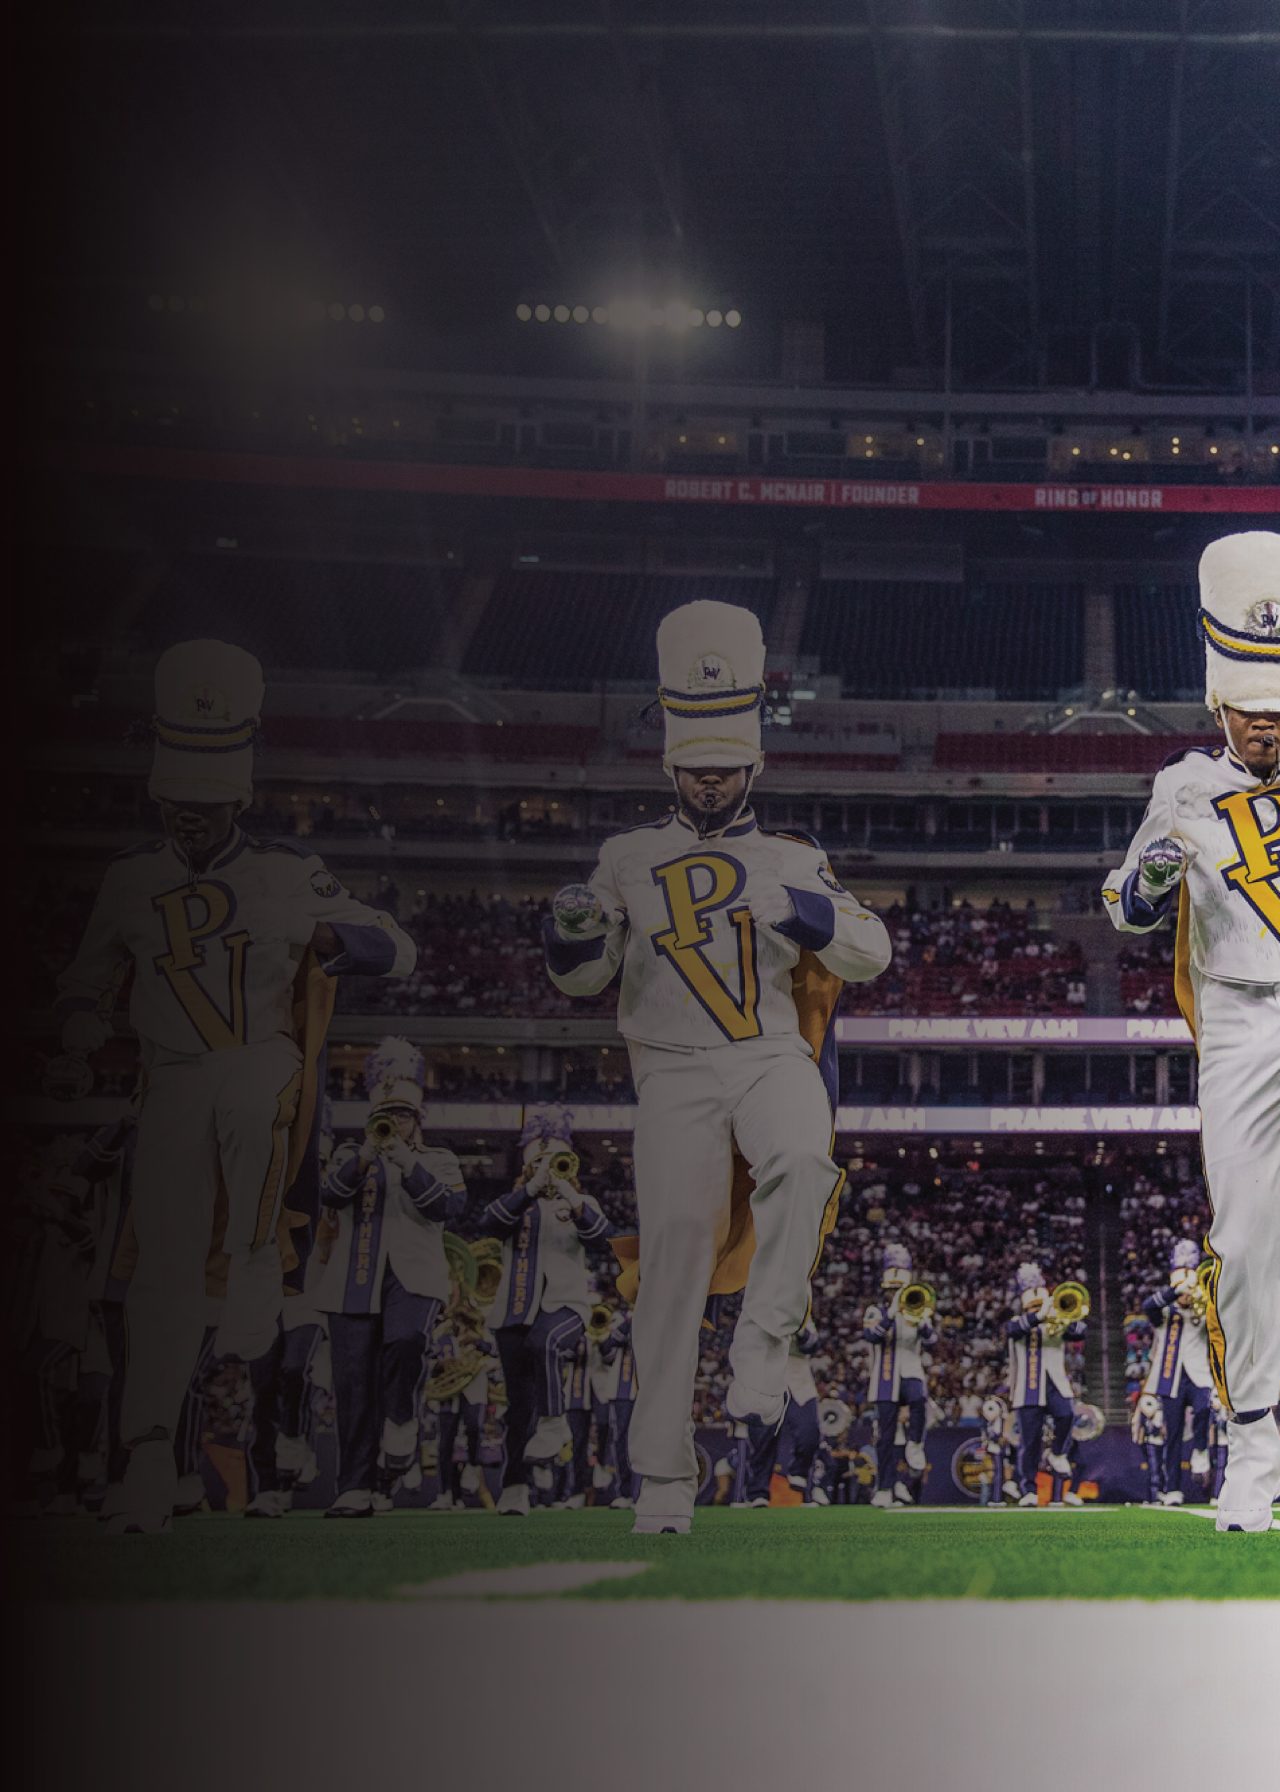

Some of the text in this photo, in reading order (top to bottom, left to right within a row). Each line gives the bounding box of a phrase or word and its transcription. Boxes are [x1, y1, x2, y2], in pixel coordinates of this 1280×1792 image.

[665, 480, 919, 505] ROBERT C. MCNAIR FOUNDER
[1034, 487, 1079, 508] RING
[1101, 489, 1163, 509] HONOR
